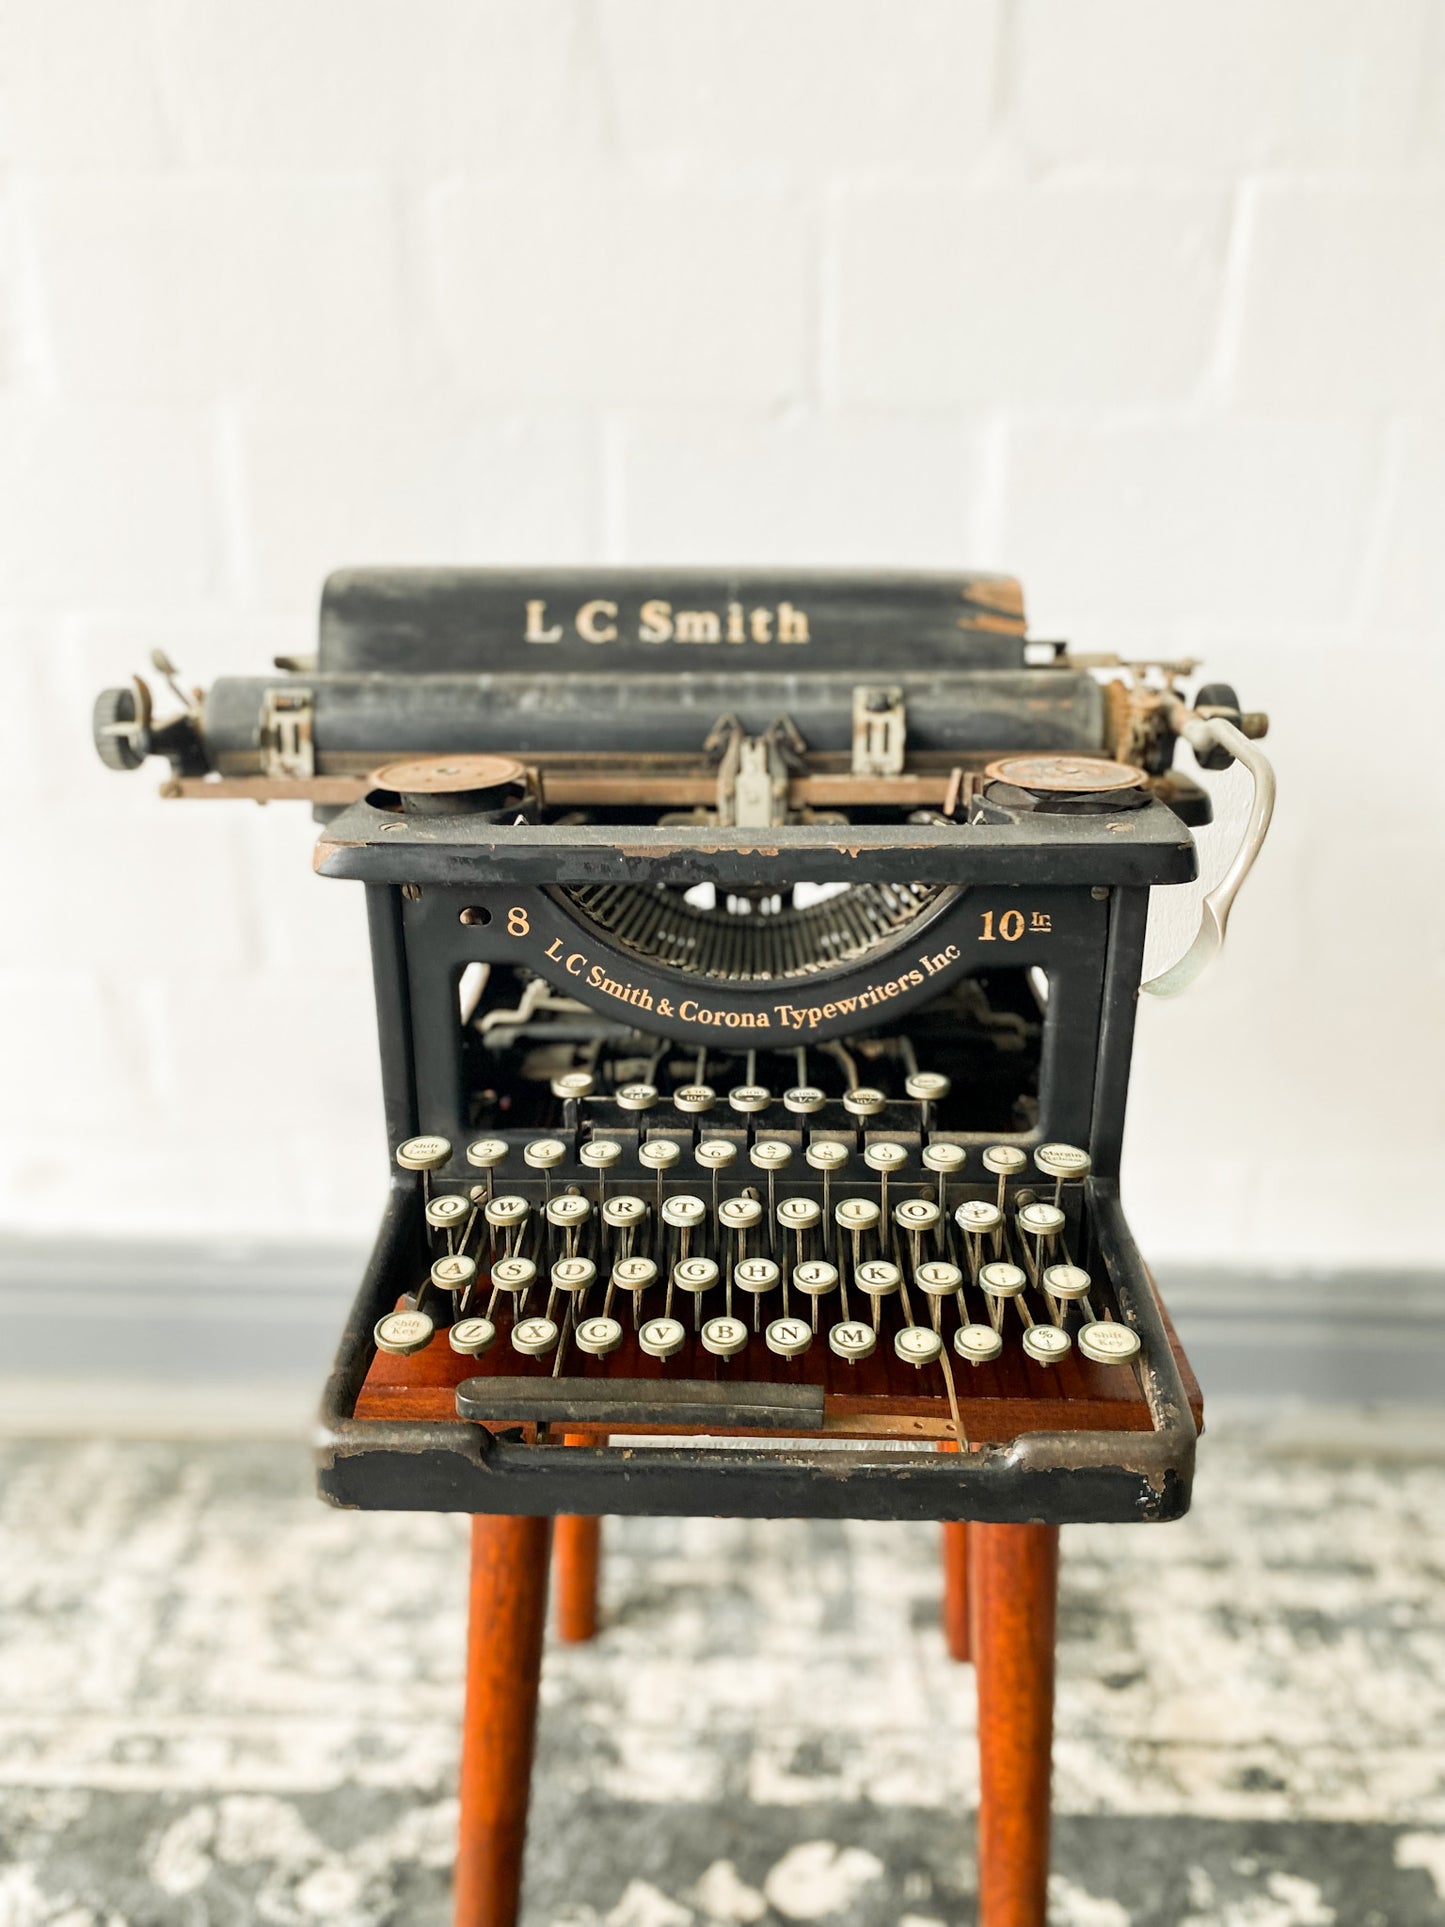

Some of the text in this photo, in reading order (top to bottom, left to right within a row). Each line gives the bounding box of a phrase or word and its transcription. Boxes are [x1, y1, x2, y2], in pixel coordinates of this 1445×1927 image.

[525, 599, 811, 644] L C Smith
[507, 906, 531, 937] 8
[978, 909, 1025, 942] 10
[544, 937, 961, 1030] L C Smith & Corona Typewriters Inc
[439, 1201, 458, 1213] Q
[499, 1202, 519, 1212] W
[562, 1201, 577, 1212] E
[617, 1202, 634, 1212] R
[675, 1202, 694, 1213] T
[733, 1204, 749, 1213] Y
[791, 1204, 807, 1213] U
[854, 1205, 861, 1215] I
[908, 1206, 927, 1216] O
[974, 1208, 988, 1218] P
[445, 1262, 463, 1276] A
[507, 1264, 522, 1275] S
[565, 1263, 585, 1275] D
[628, 1263, 646, 1274] F
[686, 1263, 706, 1276] G
[748, 1265, 767, 1277] H
[805, 1267, 821, 1280] J
[869, 1267, 888, 1280] K
[932, 1268, 949, 1280] L
[393, 1318, 422, 1328] Shift
[392, 1327, 419, 1336] Key
[463, 1325, 481, 1338] Z
[526, 1326, 546, 1338] X
[590, 1324, 608, 1338] C
[653, 1327, 672, 1340] V
[717, 1325, 734, 1339] B
[780, 1326, 799, 1340] N
[841, 1329, 865, 1343] M
